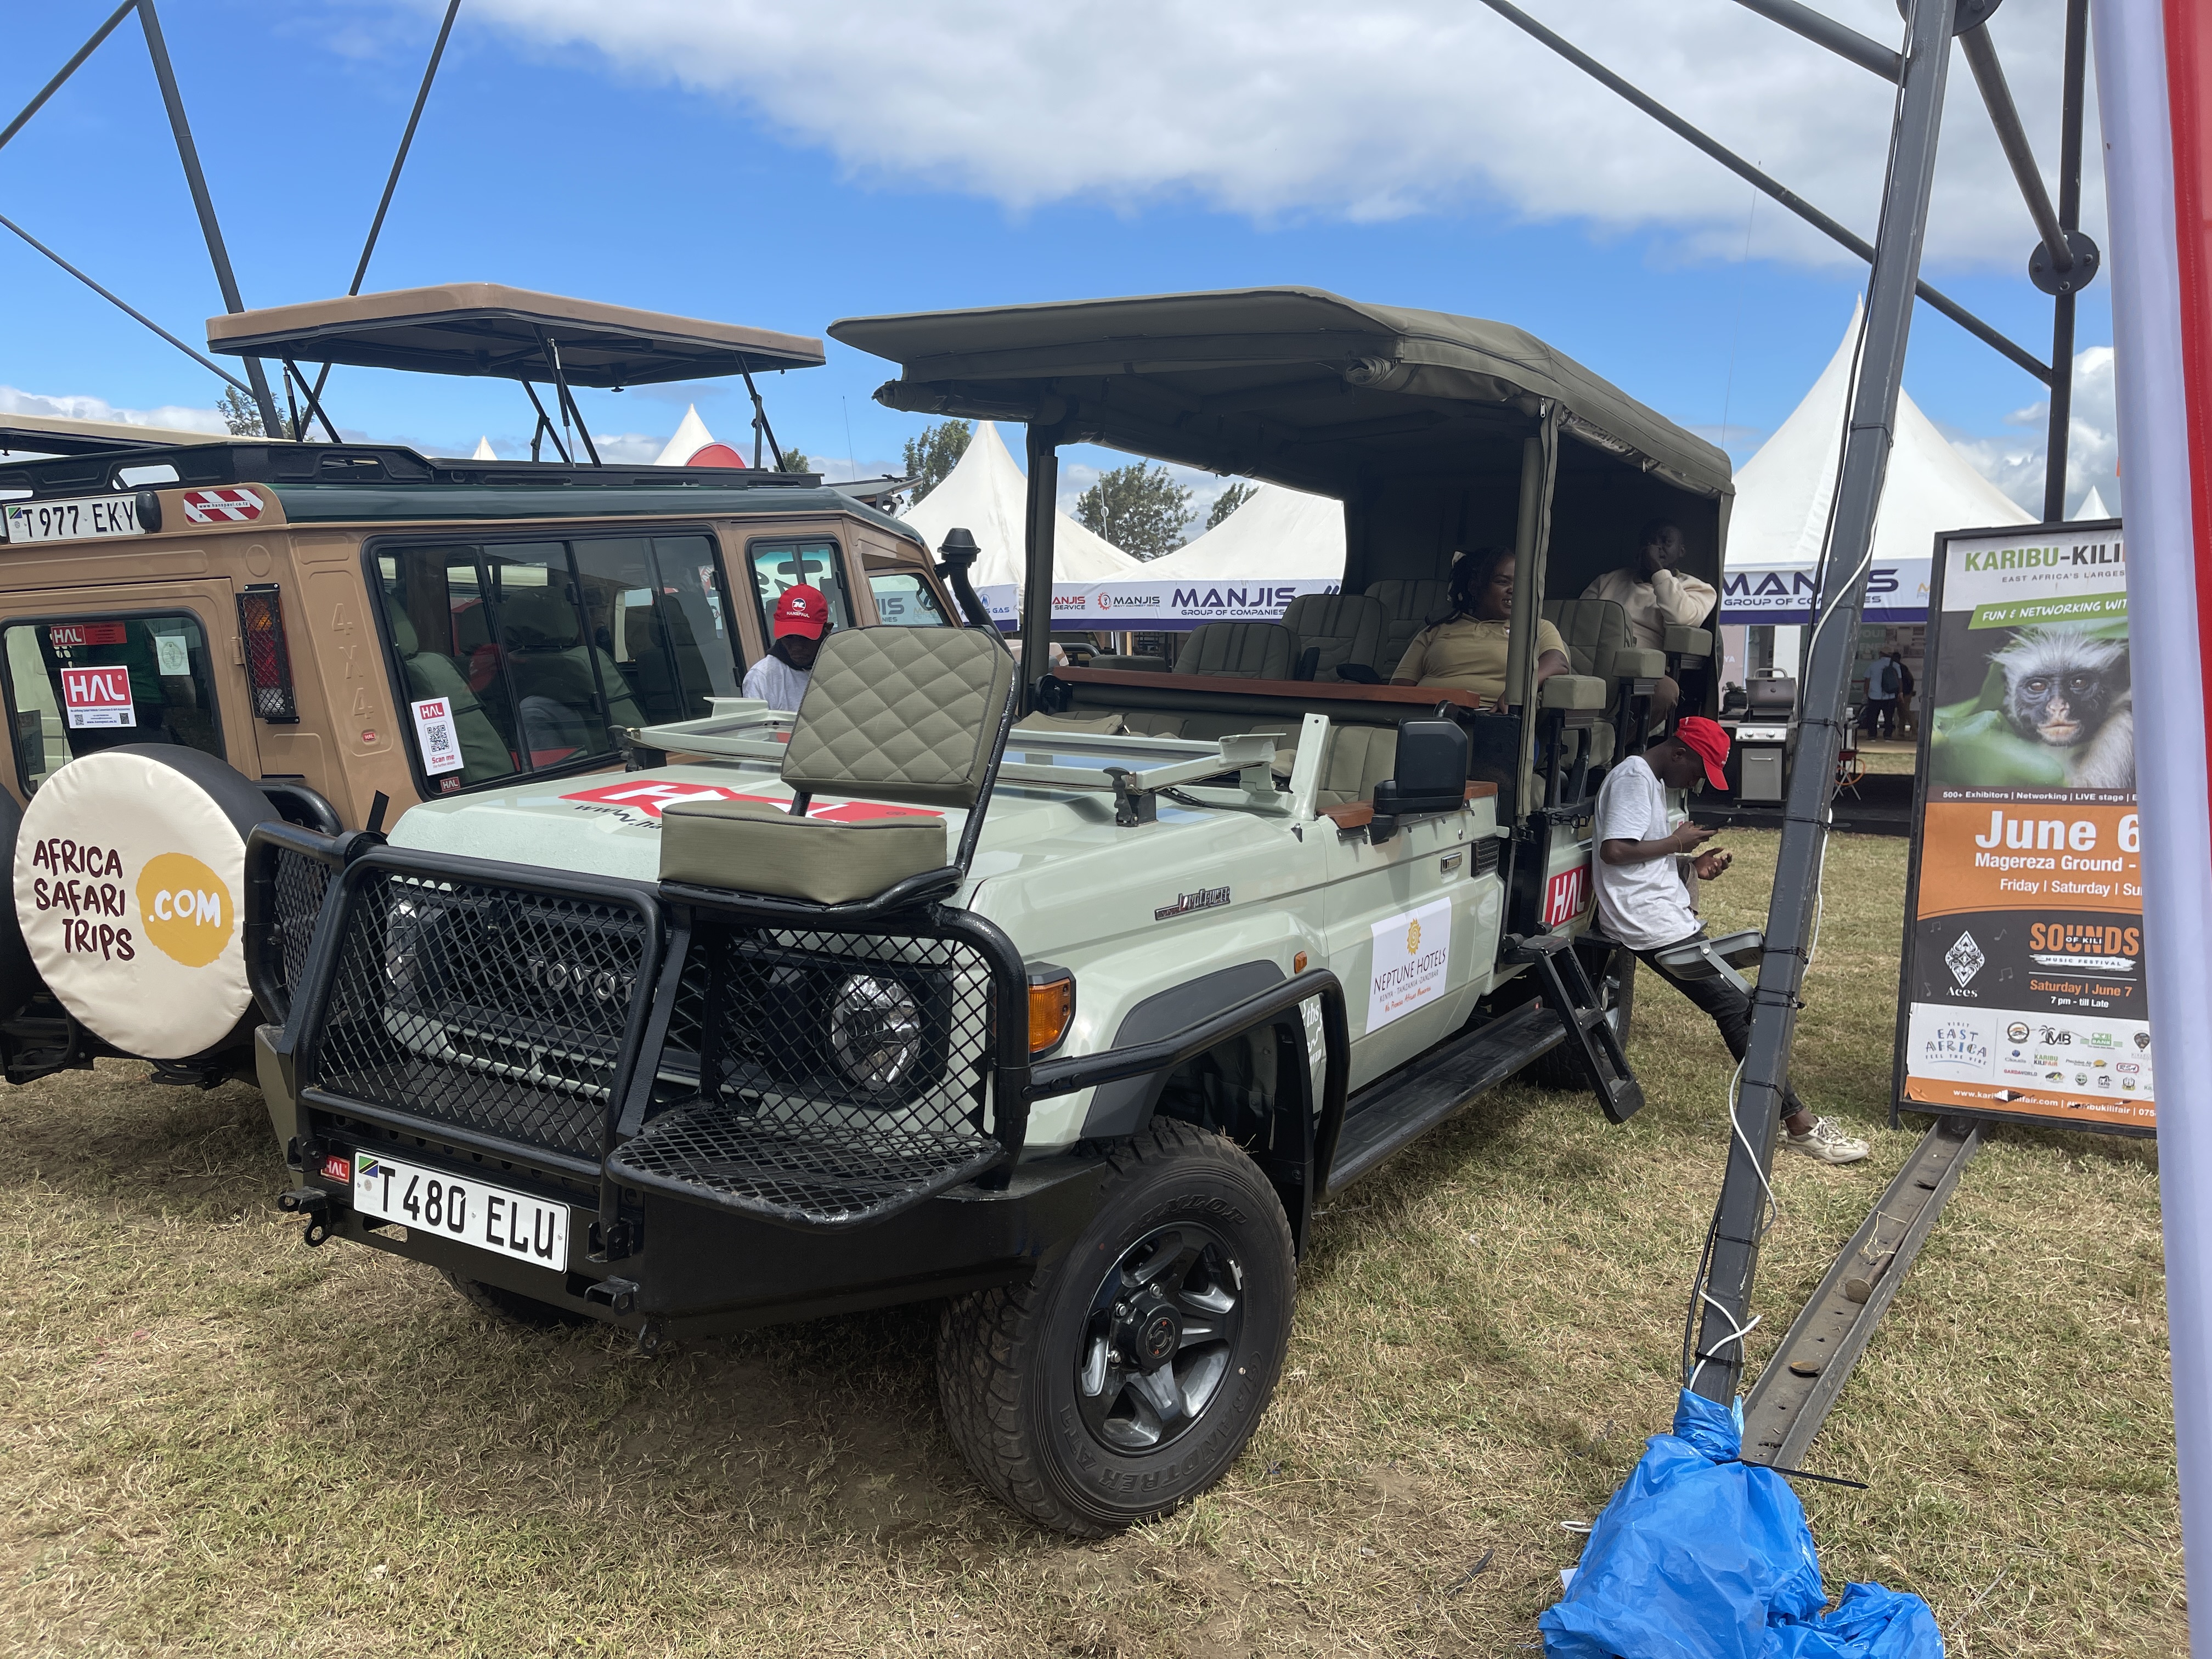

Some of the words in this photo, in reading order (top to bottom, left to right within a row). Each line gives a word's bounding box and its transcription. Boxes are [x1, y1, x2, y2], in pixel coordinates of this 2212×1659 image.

[22, 509, 33, 538] T
[39, 505, 79, 537] 977
[92, 500, 134, 533] EKY
[1965, 543, 2124, 572] KARIBU-KILI
[1723, 568, 1899, 596] MANS
[2032, 573, 2079, 581] AFRICA'S
[1051, 596, 1086, 605] ANJIS
[1171, 588, 1296, 607] MANJIS
[1724, 598, 1771, 606] GROUP
[1775, 597, 1793, 606] OF
[1982, 610, 2007, 622] FUN
[2019, 601, 2101, 618] NETWORKING
[54, 628, 82, 644] HAL
[69, 674, 126, 703] HAL
[421, 704, 443, 718] HAL
[442, 779, 459, 789] HAL
[1966, 791, 2008, 799] Exhibitors
[2016, 791, 2067, 801] Networking
[2098, 794, 2124, 802] stage
[1975, 810, 2097, 851] June
[32, 838, 123, 878] AFRICA
[1975, 852, 2055, 871] Magereza
[2061, 855, 2123, 872] Ground
[34, 878, 125, 917] SAFARI
[1551, 868, 1585, 926] HAL
[2000, 878, 2039, 895] Friday
[2051, 881, 2111, 898] Saturday
[148, 889, 221, 928] .COM
[62, 918, 135, 961] TRIPS
[2029, 922, 2140, 956] SOUNDS
[1374, 960, 1415, 995] NEPTUNE
[1417, 947, 1446, 975] HOTELS
[2078, 958, 2121, 967] FESTIVAL
[1379, 991, 1393, 1003] KENYA
[1397, 979, 1418, 995] TANZANIA
[1946, 986, 1978, 998] Aces
[2030, 979, 2081, 996] Saturday
[2092, 985, 2121, 996] June
[2124, 986, 2132, 996] 7
[2050, 996, 2057, 1005] 7
[2058, 998, 2071, 1007] pm
[2079, 997, 2090, 1007] till
[1937, 1028, 1979, 1042] EAST
[1925, 1040, 1987, 1057] AFRICA
[2138, 1108, 2156, 1117] 075
[379, 1166, 396, 1212] T
[403, 1175, 466, 1234] 480
[487, 1195, 555, 1260] ELU
